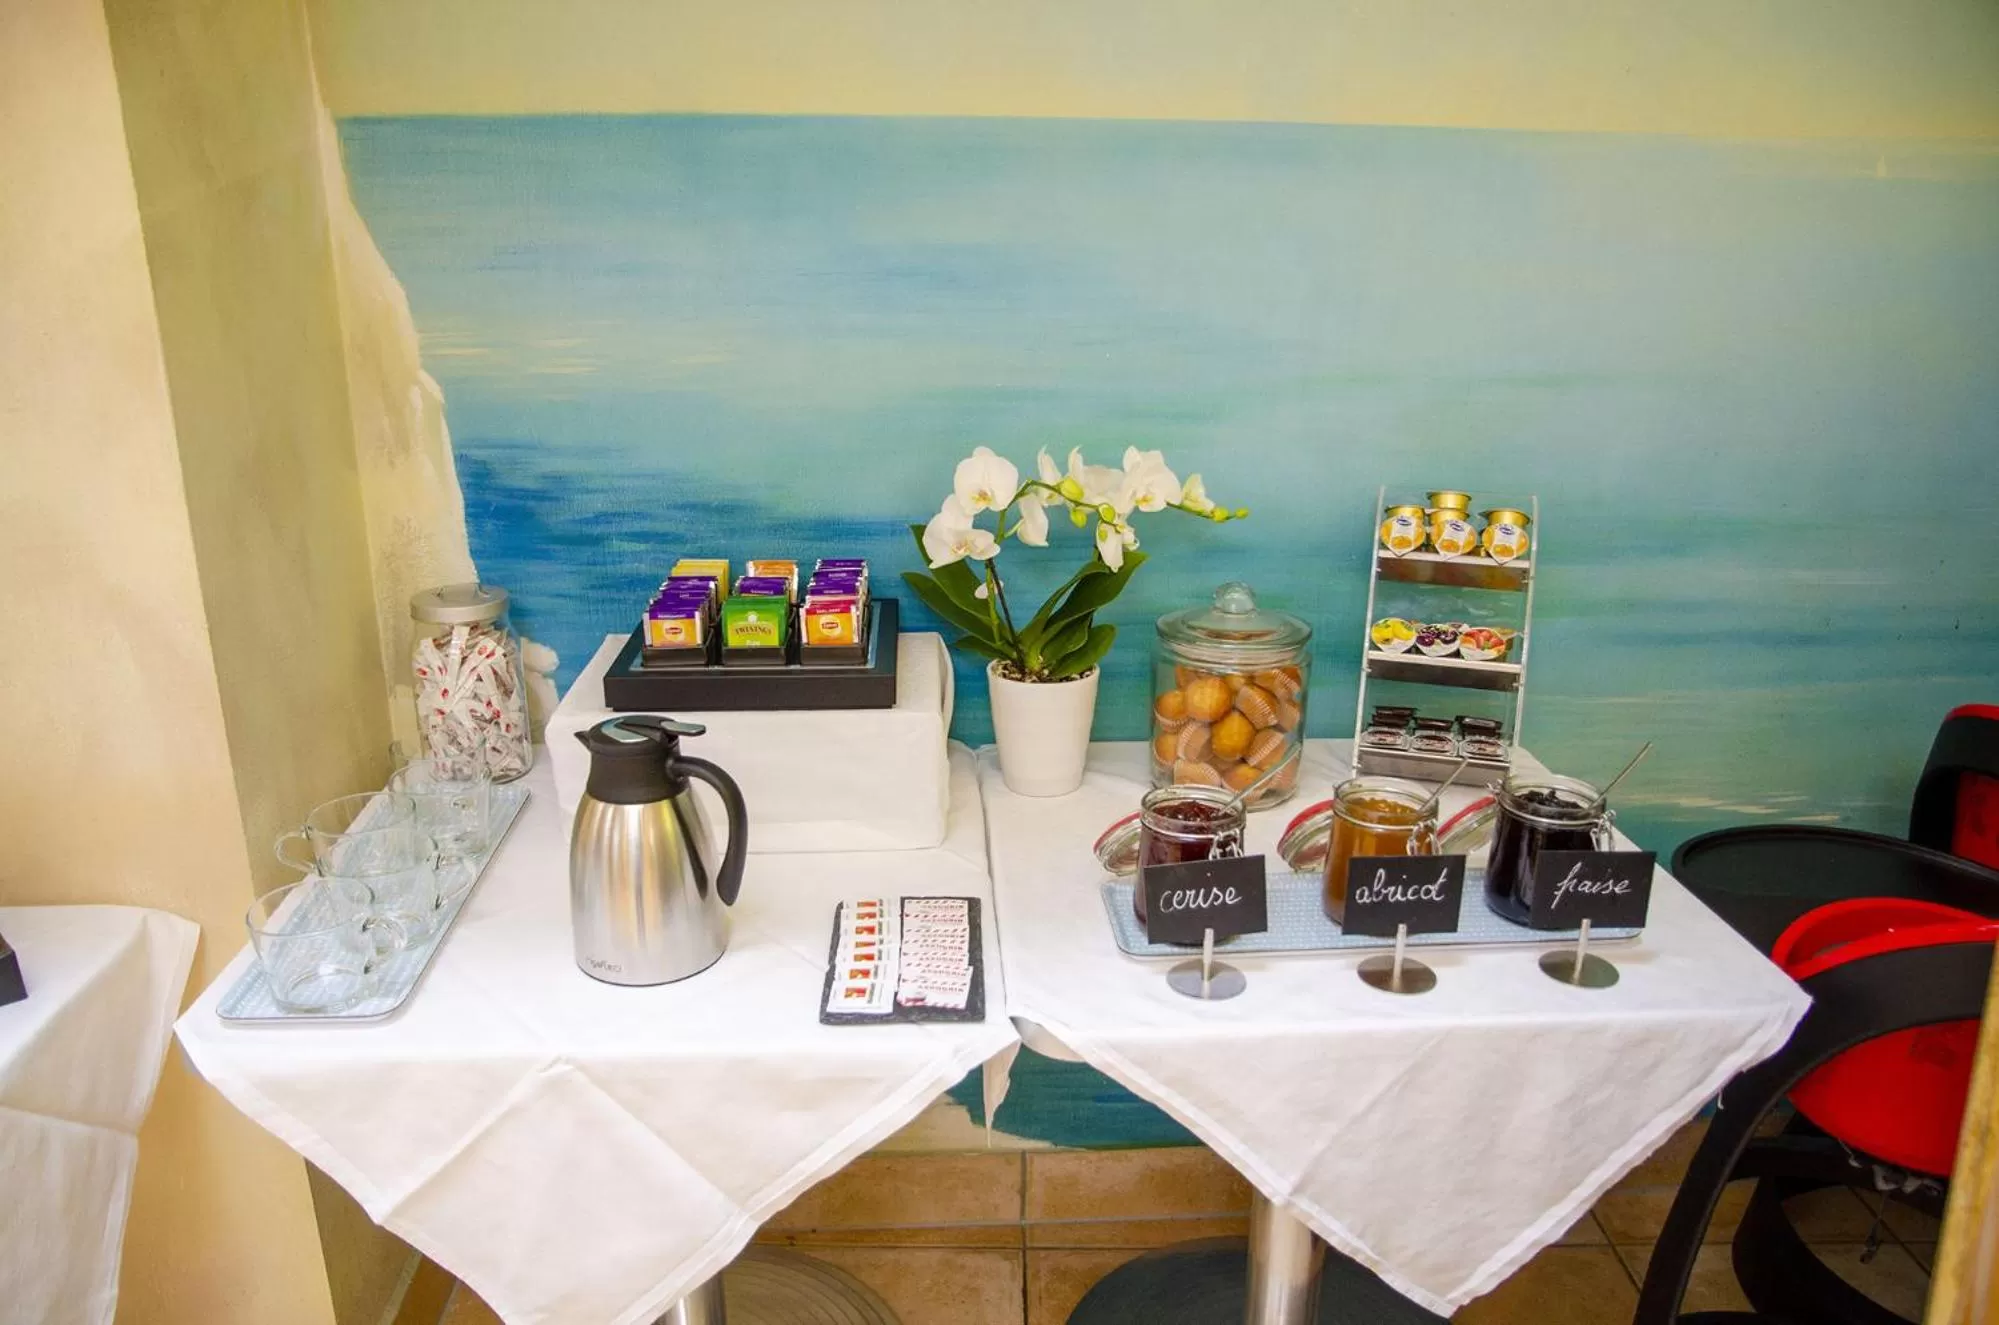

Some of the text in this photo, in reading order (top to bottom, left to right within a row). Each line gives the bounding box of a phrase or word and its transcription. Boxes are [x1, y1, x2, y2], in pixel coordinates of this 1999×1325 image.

[1160, 871, 1242, 913] cerise
[1355, 867, 1447, 903] abricot
[1550, 861, 1632, 909] fraise
